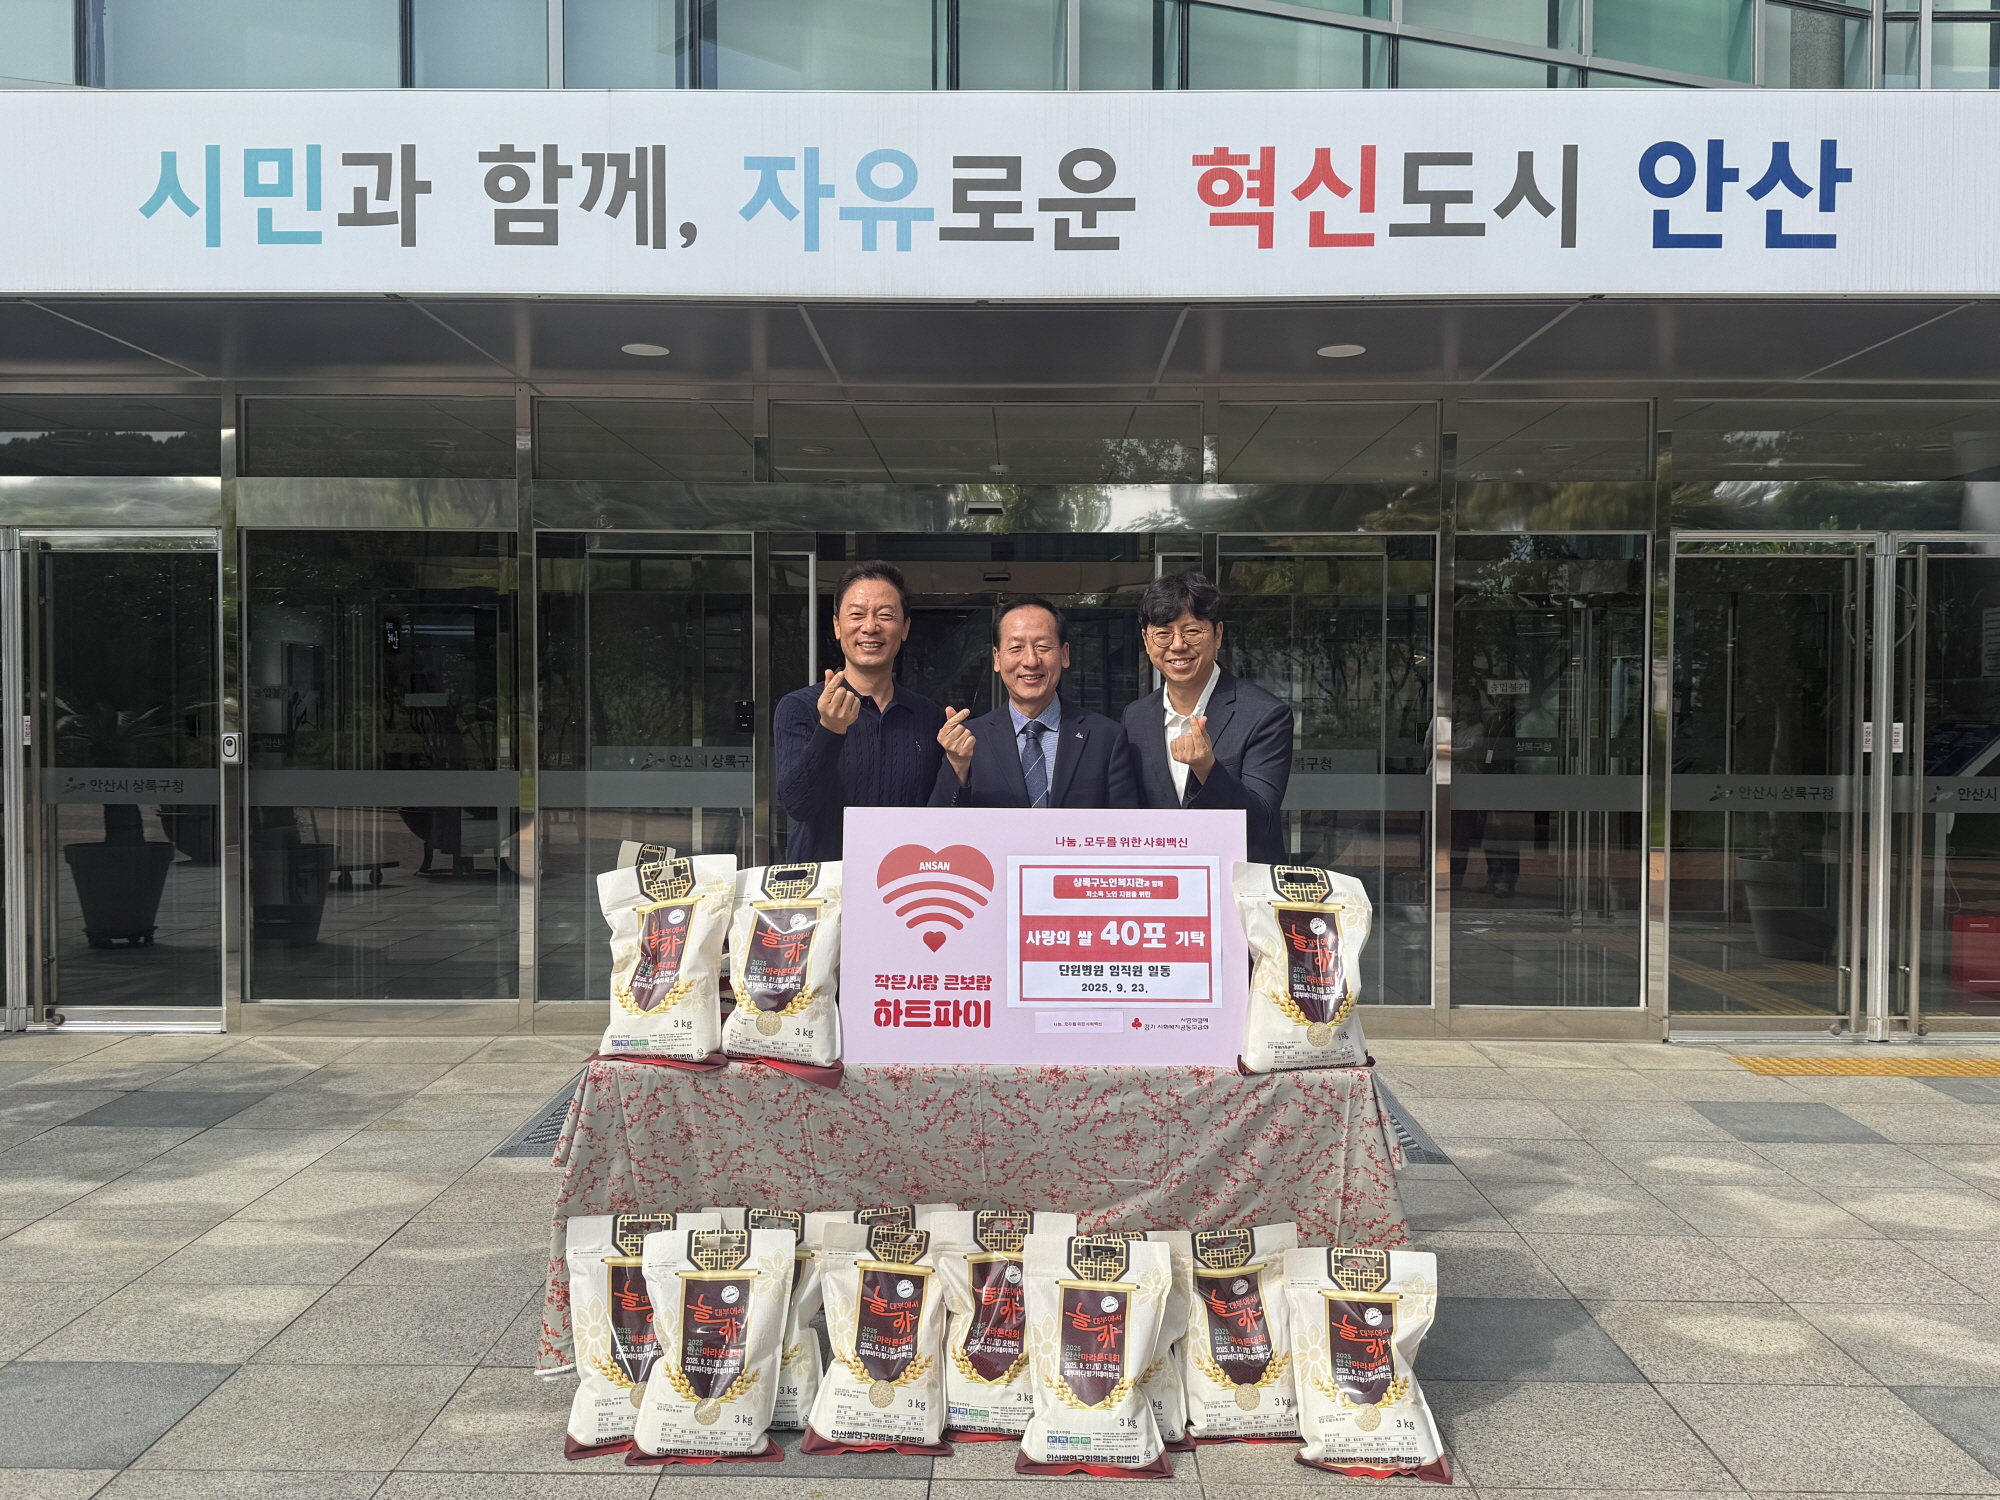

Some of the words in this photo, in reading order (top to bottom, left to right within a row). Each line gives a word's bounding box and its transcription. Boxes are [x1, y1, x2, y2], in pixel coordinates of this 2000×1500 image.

[139, 143, 431, 248] 시민과
[479, 143, 697, 249] 함께,
[739, 146, 1136, 251] 자유로운
[1192, 144, 1578, 249] 혁신도시
[1639, 139, 1852, 249] 안산
[711, 754, 753, 768] 상록구
[90, 779, 129, 793] 안산시
[132, 779, 184, 793] 상록구청
[1738, 786, 1778, 800] 안산시
[1782, 786, 1834, 800] 상록구청
[1958, 787, 1997, 801] 안산시
[1084, 837, 1117, 848] 모두를
[1119, 837, 1141, 848] 위한
[1143, 837, 1188, 849] 사회백신
[919, 861, 951, 873] ANSAN
[1085, 890, 1104, 898] 저소득
[1106, 890, 1118, 898] 노인
[1119, 890, 1138, 898] 지원을
[1139, 890, 1151, 898] 위한
[1026, 930, 1071, 946] 사랑의
[1077, 930, 1093, 946] 쌀
[1100, 920, 1167, 948] 40포
[1175, 931, 1206, 946] 기탁
[751, 959, 767, 967] 2025
[1058, 964, 1104, 977] 단원병원
[1109, 964, 1143, 978] 임직원
[1148, 965, 1171, 978] 일동
[874, 974, 940, 991] 작은사랑
[943, 974, 993, 992] 큰보람
[1081, 982, 1112, 993] 2025.
[1116, 983, 1127, 993] 9.
[1131, 983, 1148, 993] 23.
[874, 998, 992, 1029] 하트파이
[673, 1019, 679, 1028] 3
[681, 1019, 693, 1029] kg
[795, 1028, 801, 1036] 3
[802, 1028, 814, 1039] kg
[890, 1301, 918, 1310] 대부에서
[1093, 1314, 1122, 1325] 대부에서
[863, 1326, 878, 1334] 2025
[1065, 1352, 1120, 1363] 안산마라톤대회
[779, 1386, 785, 1394] 3
[787, 1386, 798, 1396] kg
[1016, 1393, 1022, 1402] 3
[1024, 1393, 1034, 1404] kg
[1274, 1397, 1280, 1406] 3
[1281, 1397, 1291, 1407] kg
[907, 1399, 913, 1408] 3
[915, 1399, 926, 1411] kg
[1152, 1399, 1163, 1410] kg
[734, 1414, 740, 1424] 3
[742, 1414, 753, 1426] kg
[1119, 1418, 1125, 1427] 3
[1127, 1418, 1138, 1429] kg
[1396, 1419, 1402, 1428] 3
[1403, 1419, 1415, 1430] kg
